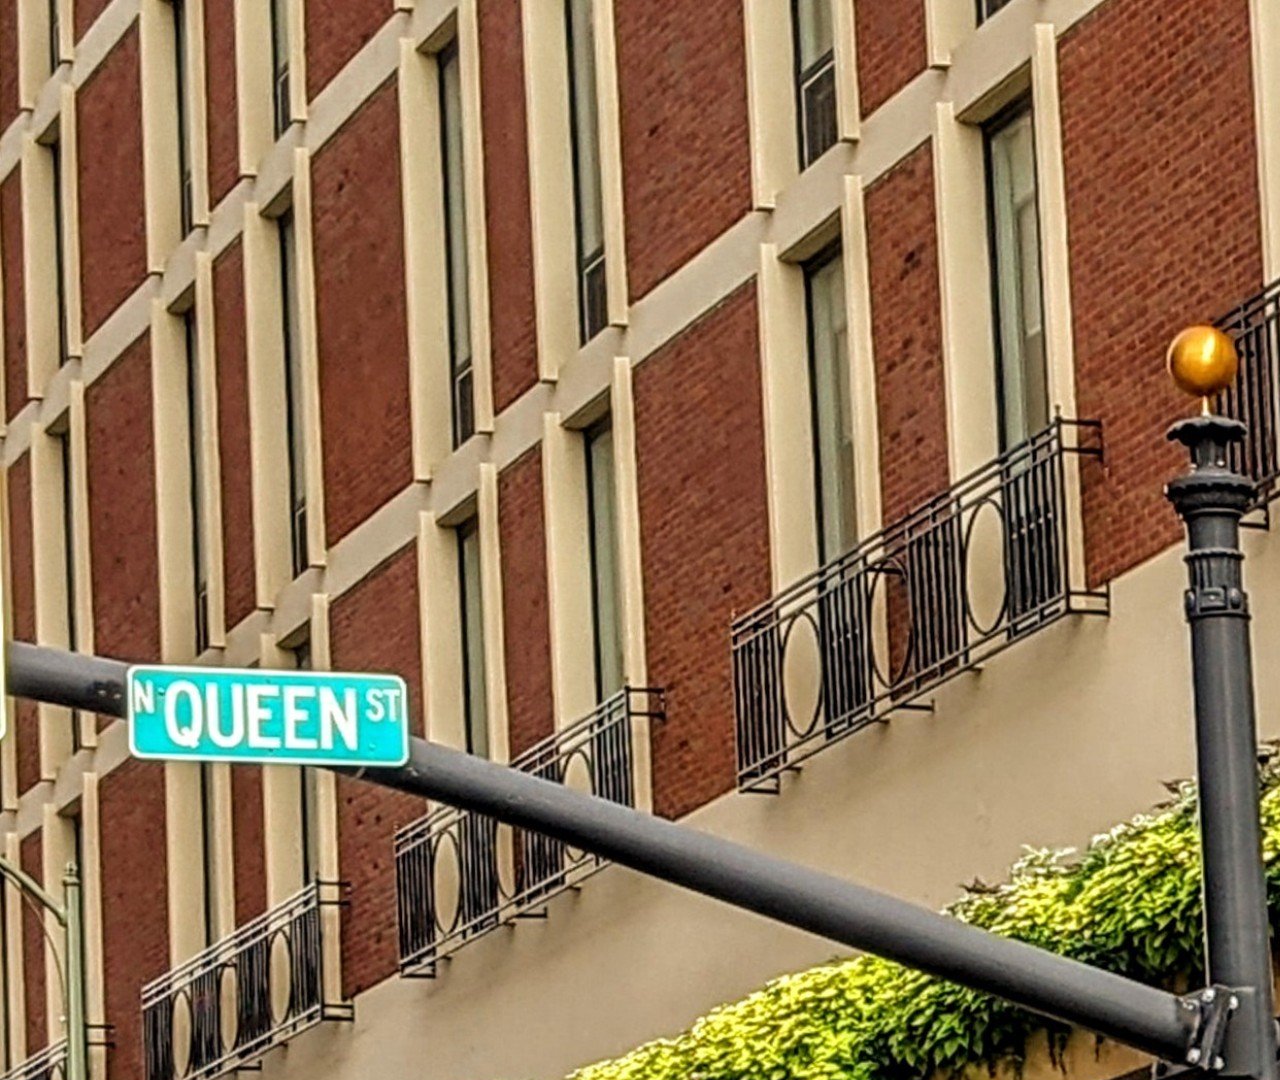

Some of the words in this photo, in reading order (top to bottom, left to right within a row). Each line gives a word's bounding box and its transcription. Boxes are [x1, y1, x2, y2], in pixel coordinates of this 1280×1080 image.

[134, 679, 155, 714] N
[164, 680, 359, 750] QUEEN
[366, 688, 400, 722] ST
